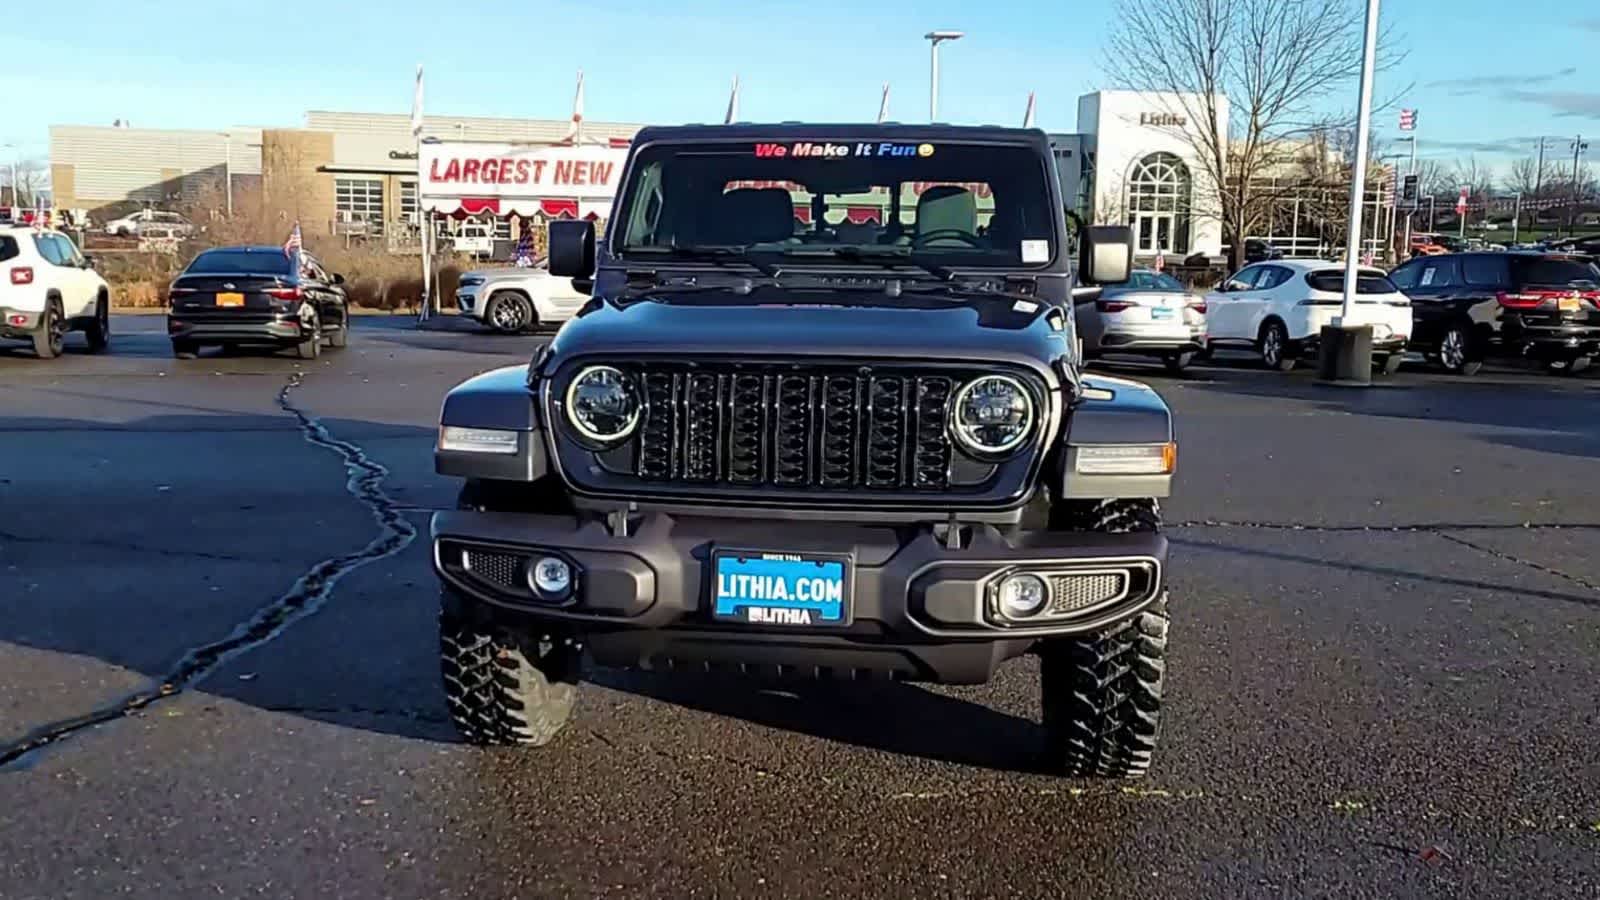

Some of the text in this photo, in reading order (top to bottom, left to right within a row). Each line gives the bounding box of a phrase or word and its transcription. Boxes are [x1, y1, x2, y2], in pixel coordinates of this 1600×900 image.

[755, 143, 917, 157] We Make It Fun
[429, 158, 613, 186] LARGEST NEW
[717, 573, 843, 603] LITHIA.COM
[763, 607, 812, 625] LITHIA
